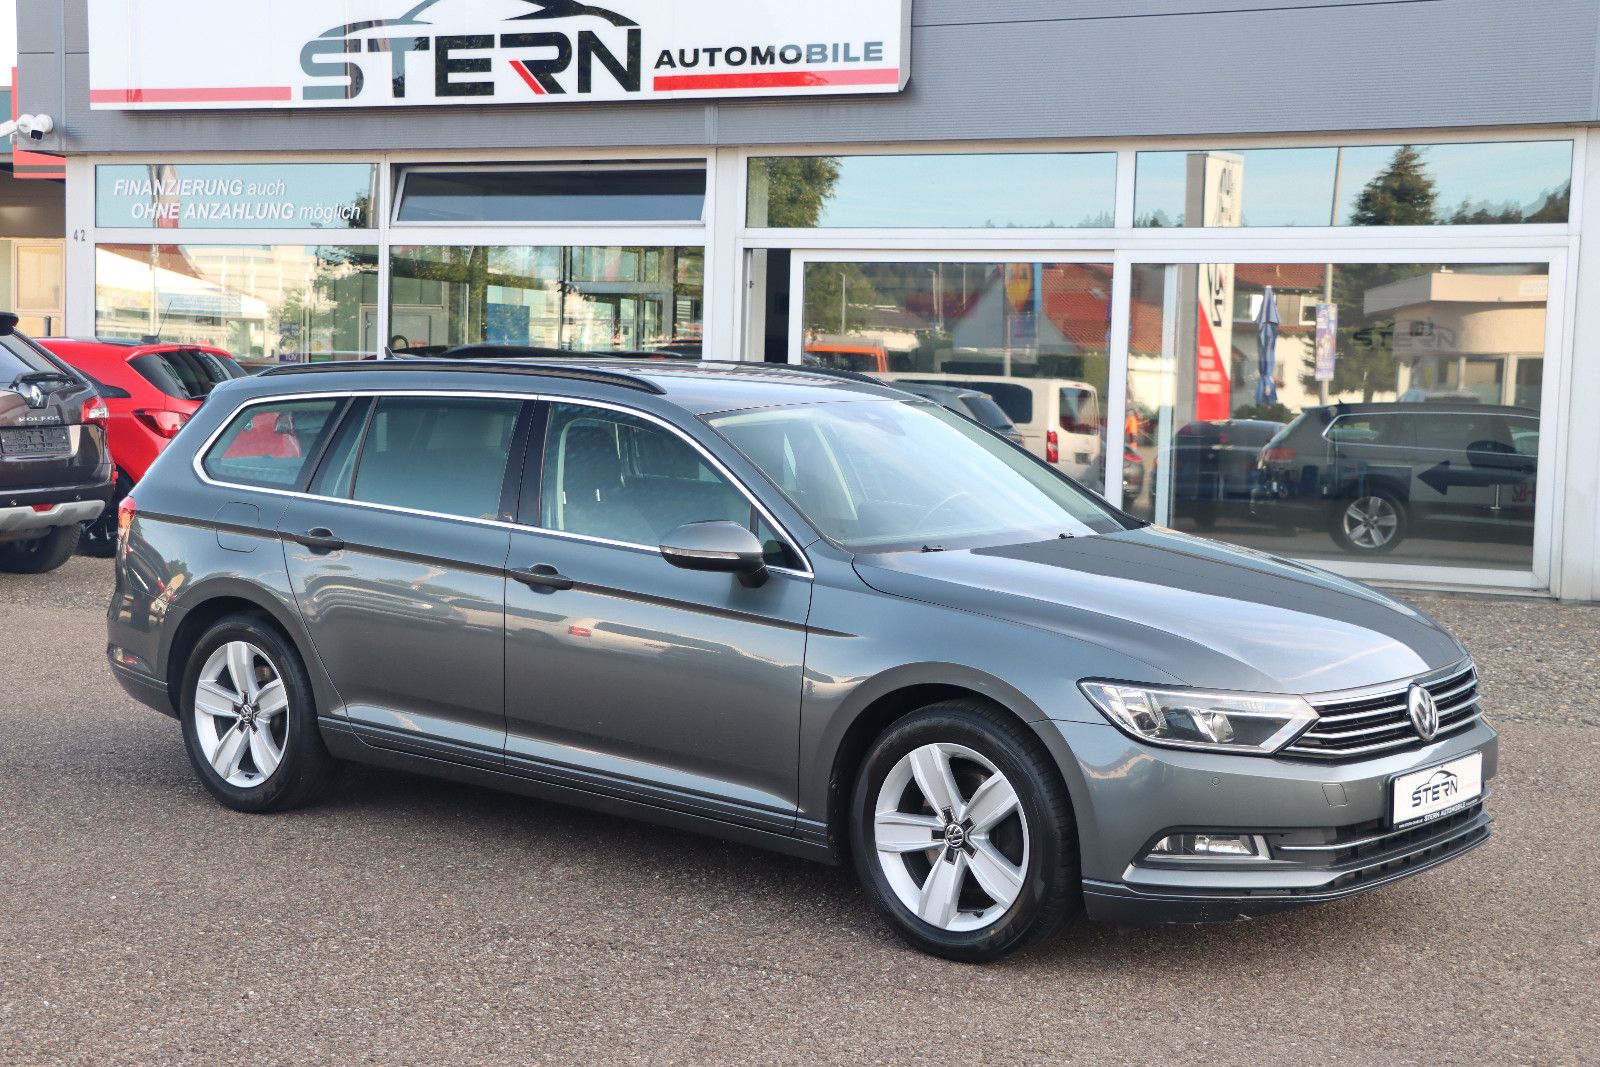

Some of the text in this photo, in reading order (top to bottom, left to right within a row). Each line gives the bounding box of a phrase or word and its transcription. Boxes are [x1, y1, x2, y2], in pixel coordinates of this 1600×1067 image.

[300, 28, 883, 100] STERN AUTOMOBILE
[113, 179, 286, 196] FINANZIERUNG auch
[131, 202, 361, 222] OHNE ANZAHLUNG möglich
[73, 229, 86, 242] 42
[1412, 778, 1459, 808] STERN
[1424, 811, 1440, 822] STERN
[1440, 801, 1467, 817] AUTOMOBILE
